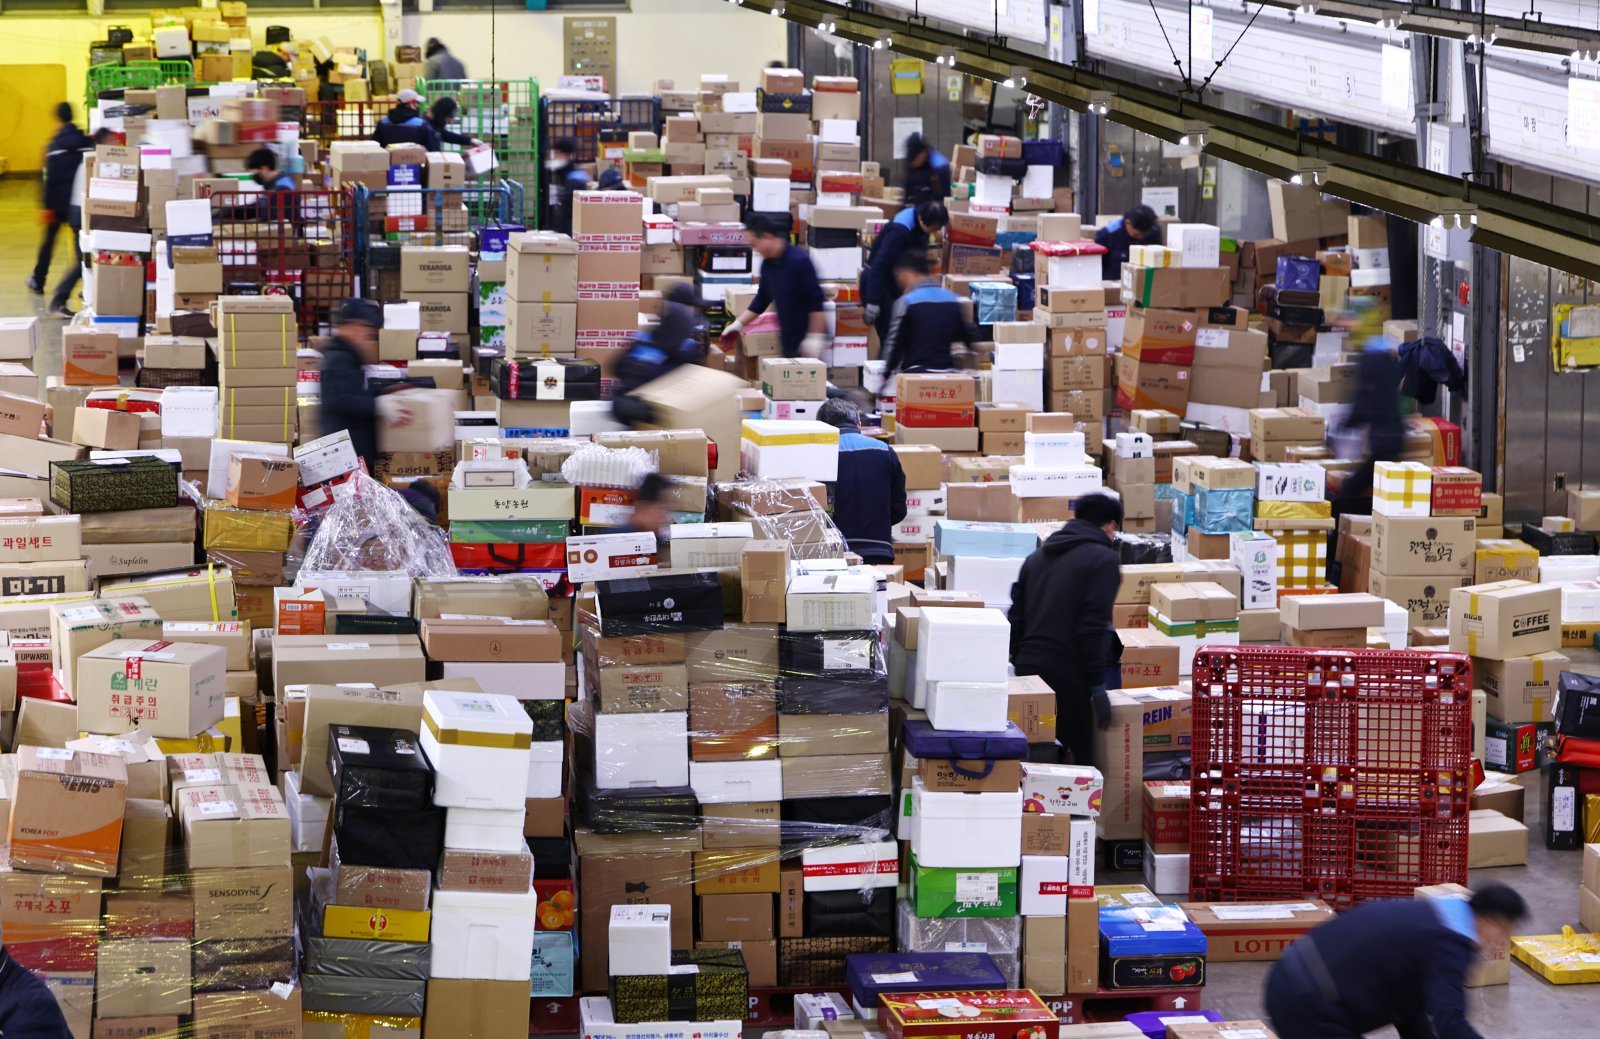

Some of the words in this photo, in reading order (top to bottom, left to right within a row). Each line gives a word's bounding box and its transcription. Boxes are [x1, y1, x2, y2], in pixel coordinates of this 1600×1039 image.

[117, 556, 149, 568] Suplelin
[21, 653, 49, 661] UPWARD
[1142, 665, 1162, 676] 소포
[112, 694, 156, 706] 취급주의
[209, 888, 261, 898] SENSODYNE
[14, 900, 42, 912] 우체국
[44, 900, 71, 914] 소포
[1234, 938, 1297, 954] LOTT
[1046, 1000, 1073, 1014] PP
